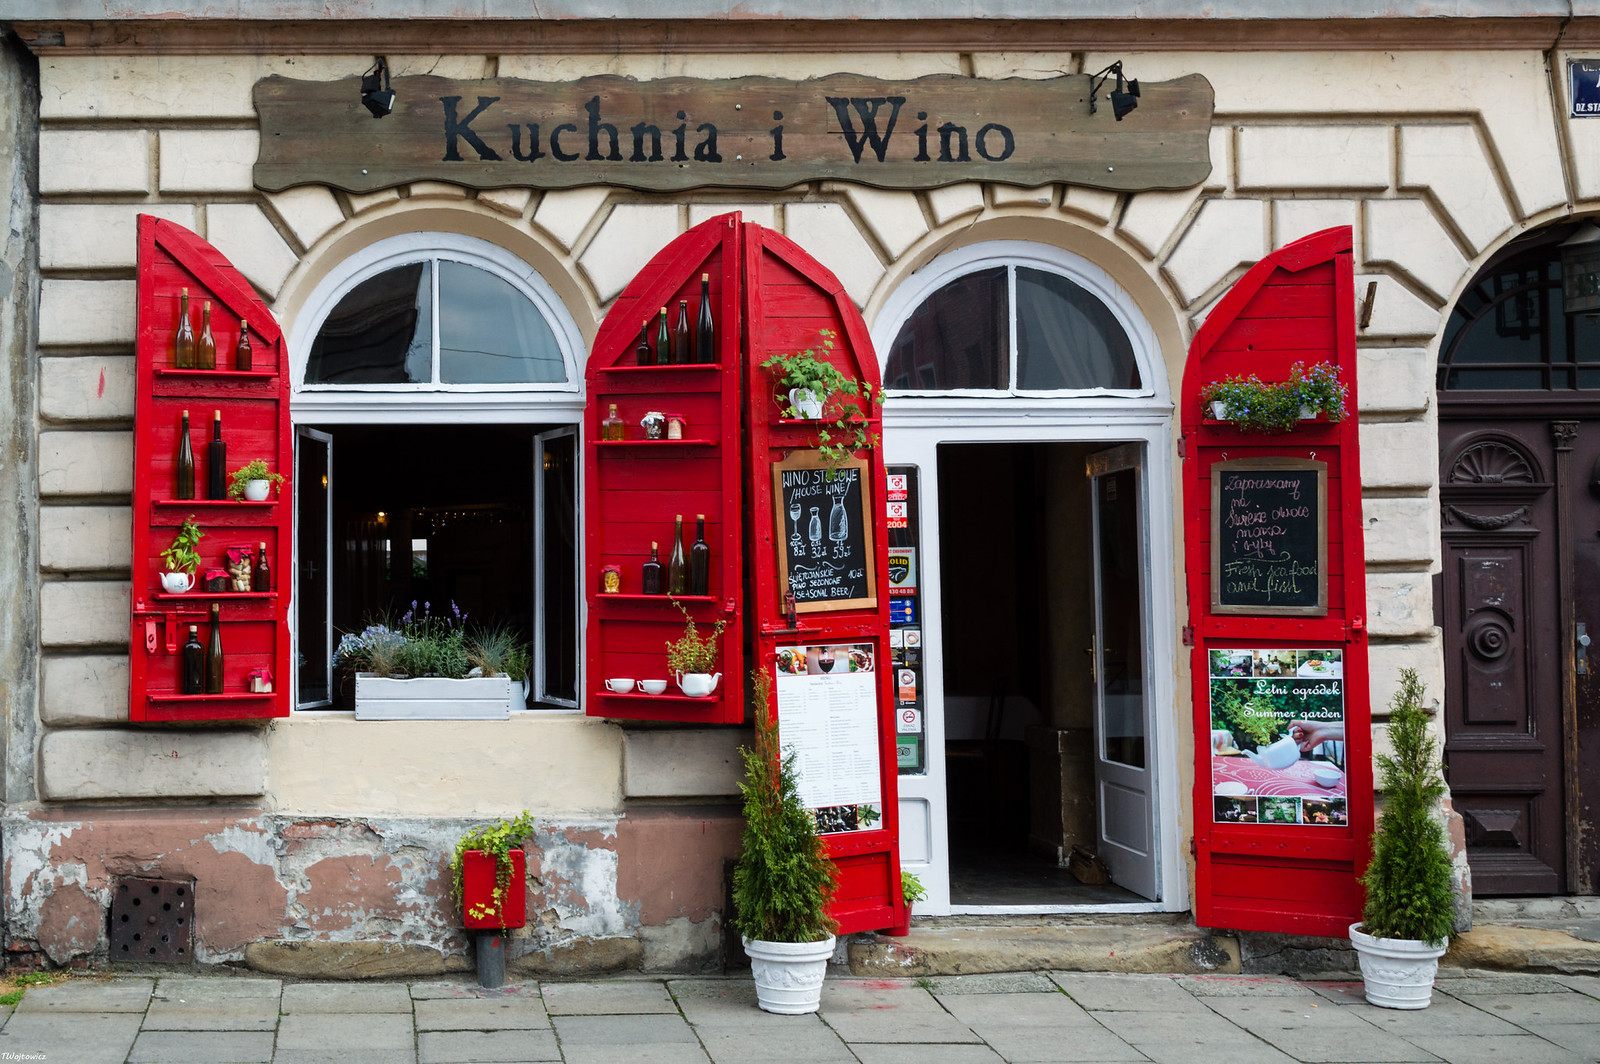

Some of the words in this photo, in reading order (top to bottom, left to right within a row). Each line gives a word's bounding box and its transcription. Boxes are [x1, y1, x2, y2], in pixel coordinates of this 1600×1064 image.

[439, 95, 723, 162] Kuchnia
[769, 110, 787, 161] i
[825, 96, 1015, 163] Wino
[782, 470, 810, 488] WINO
[812, 468, 859, 484] STOWE
[1225, 475, 1301, 499] Zapraszamy
[887, 520, 907, 529] 2004
[1226, 577, 1260, 594] and
[1253, 680, 1289, 695] Letni
[1292, 681, 1341, 701] ogródek
[1243, 702, 1296, 718] Summer
[1299, 706, 1342, 722] garden
